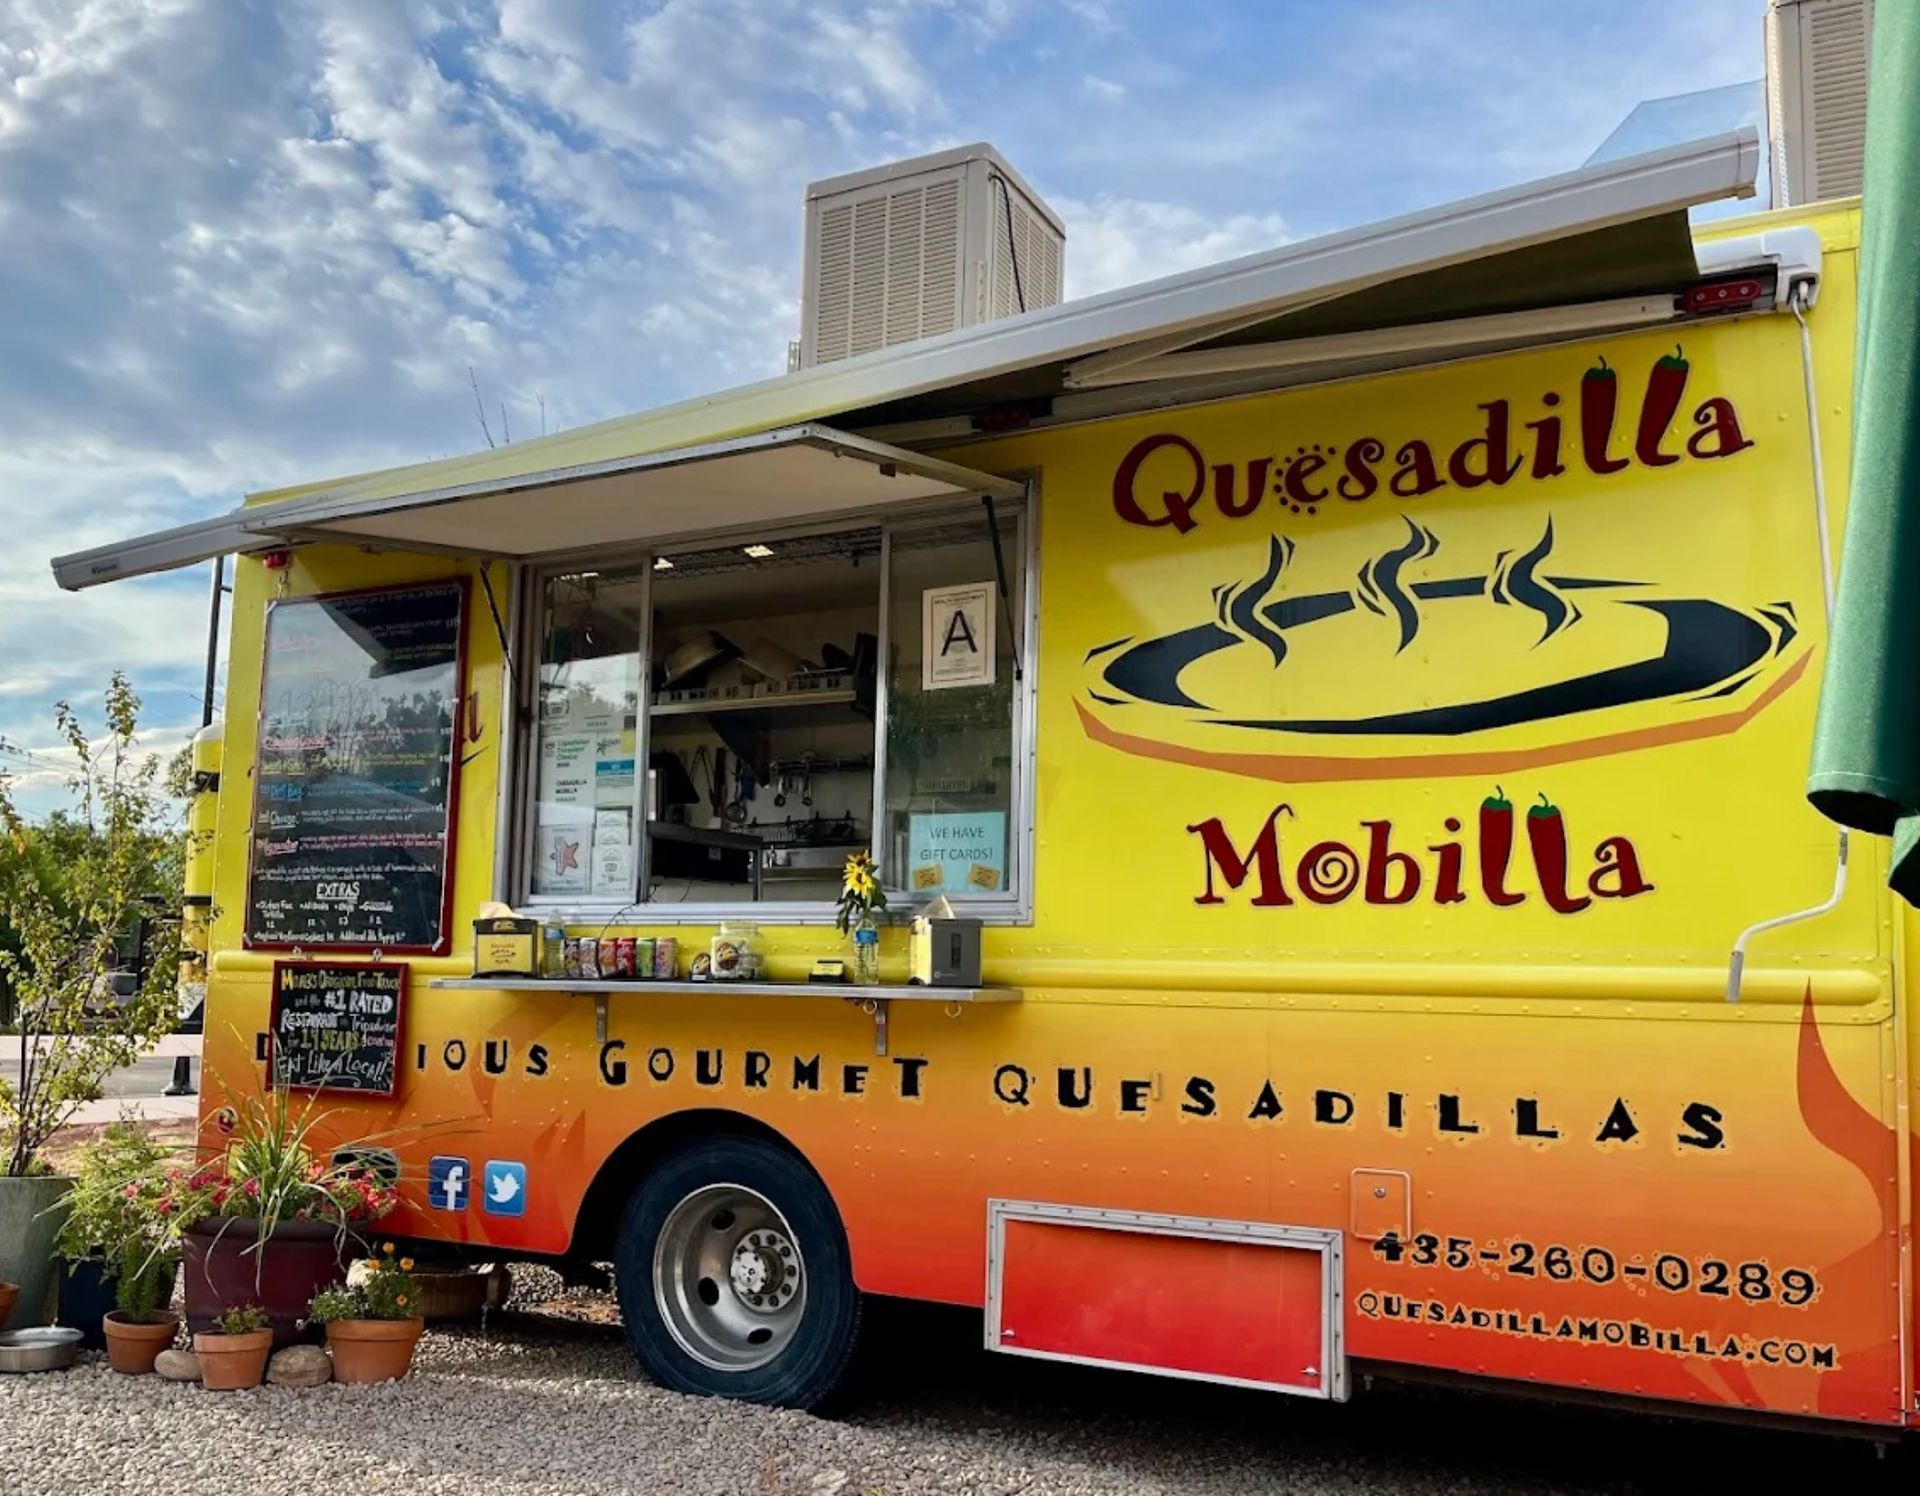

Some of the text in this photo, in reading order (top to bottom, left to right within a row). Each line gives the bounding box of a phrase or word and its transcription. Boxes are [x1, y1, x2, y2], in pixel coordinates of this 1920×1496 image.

[1112, 343, 1754, 535] Quesadilla
[941, 609, 977, 656] A
[920, 847, 993, 860] GIFT CARDS!
[930, 826, 985, 839] WE HAVE
[1186, 785, 1655, 915] Mobilla
[316, 881, 360, 898] EXTRAS
[324, 989, 347, 1011] #1
[350, 990, 394, 1015] RATED
[320, 1029, 360, 1051] YEARS
[600, 1040, 928, 1097] GOURMET
[993, 1064, 1726, 1150] QUESADILLAS
[1372, 1231, 1817, 1306] 435-260-0289
[1357, 1292, 1836, 1369] QUESADILLAMOBILLA.COM
